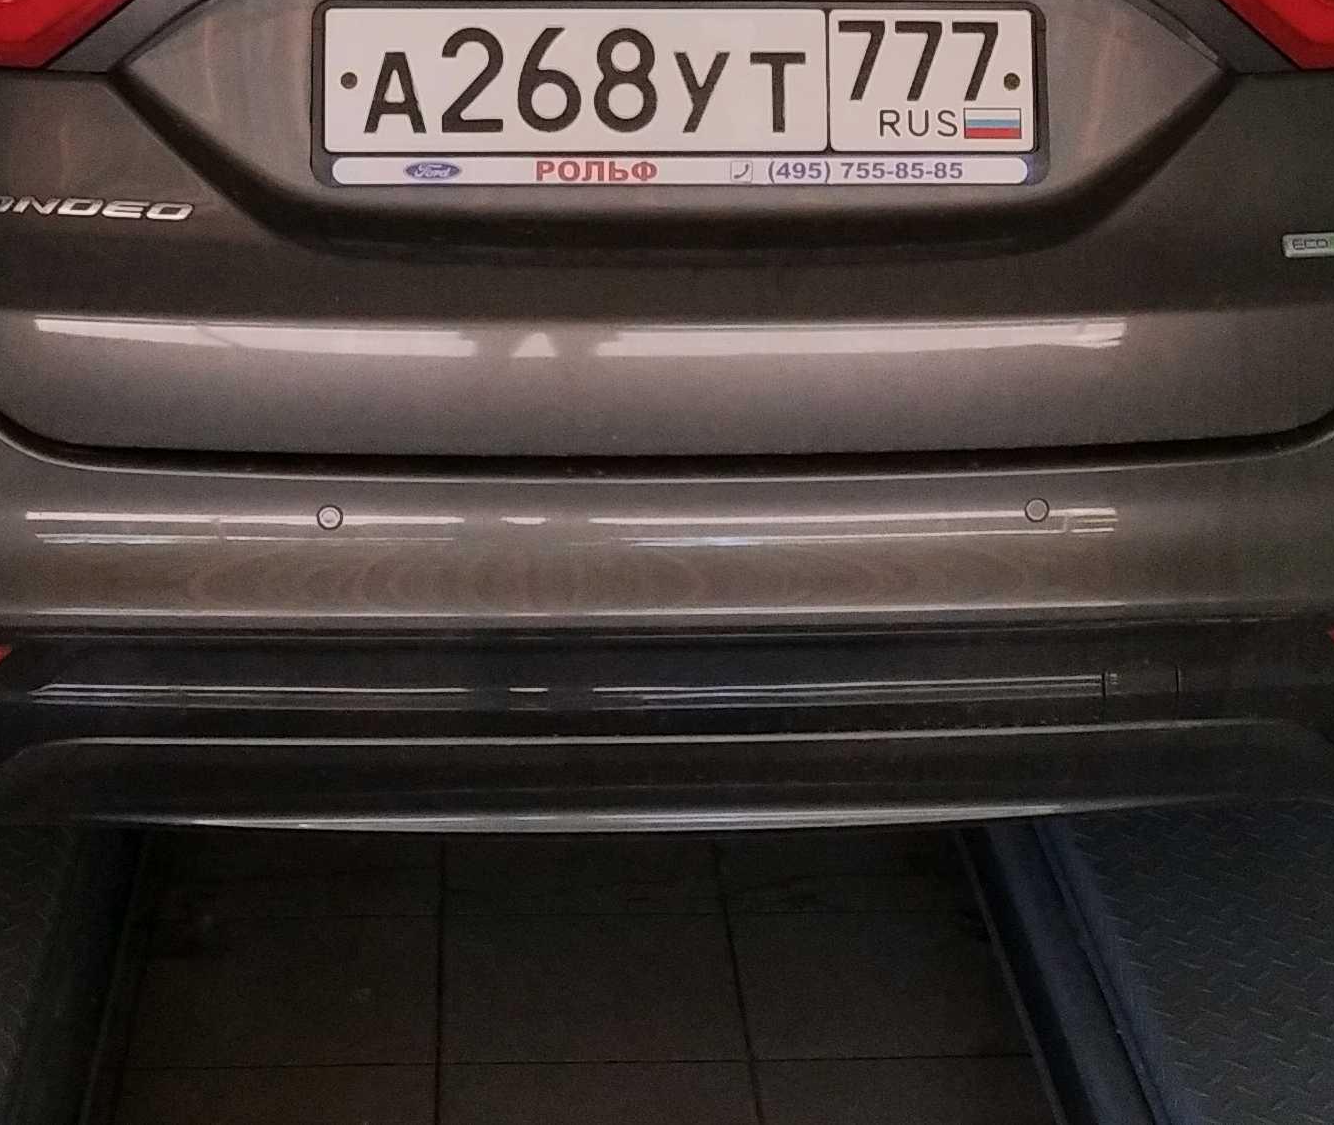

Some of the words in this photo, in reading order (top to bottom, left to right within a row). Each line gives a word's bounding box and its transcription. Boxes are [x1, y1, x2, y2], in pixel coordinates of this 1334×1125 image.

[838, 20, 1000, 102] 777
[878, 110, 958, 137] RUS
[535, 160, 658, 182] РОЛЬФ
[768, 161, 831, 183] (495)
[840, 162, 963, 180] 755-85-85
